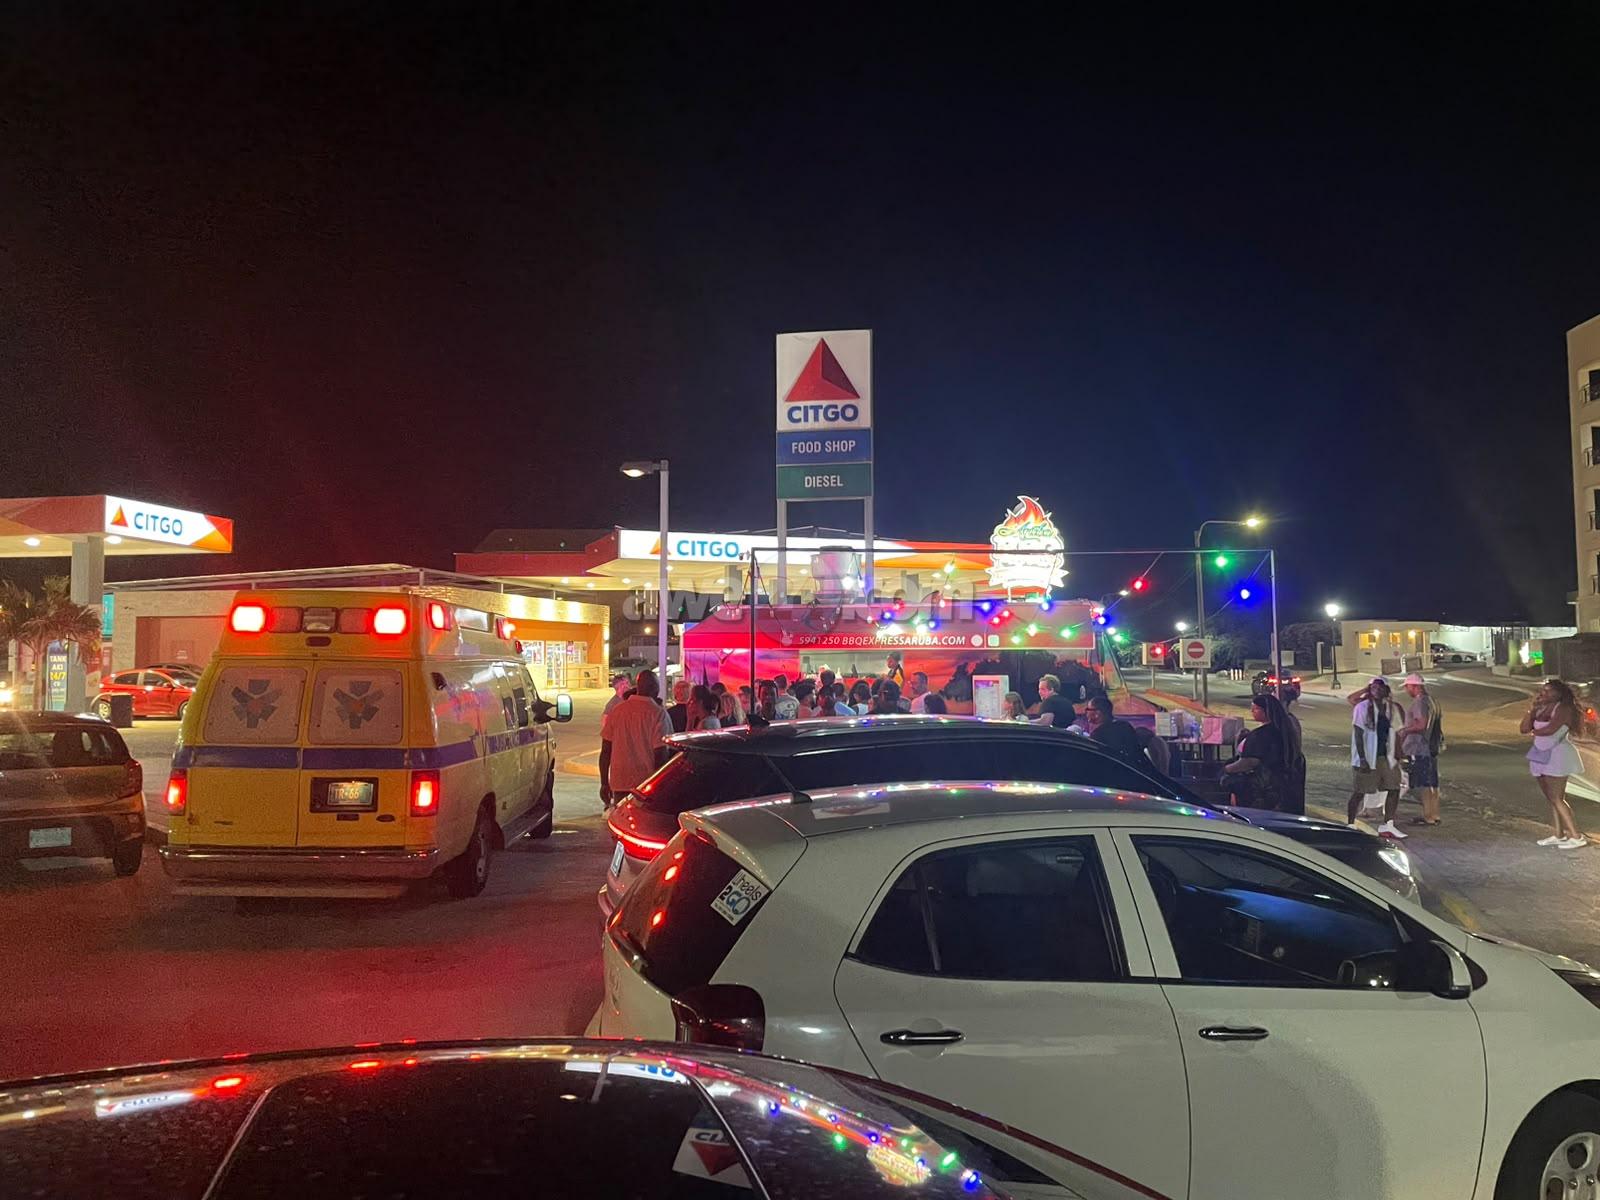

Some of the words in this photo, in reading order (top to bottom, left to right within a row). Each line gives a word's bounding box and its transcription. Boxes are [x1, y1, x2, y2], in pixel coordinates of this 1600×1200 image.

[787, 404, 859, 424] CITGO
[791, 441, 822, 454] FOOD
[825, 440, 856, 453] SHOP
[804, 475, 844, 488] DIESEL
[133, 512, 183, 536] CITGO
[676, 540, 739, 558] CITGO
[799, 636, 840, 646] 5941250
